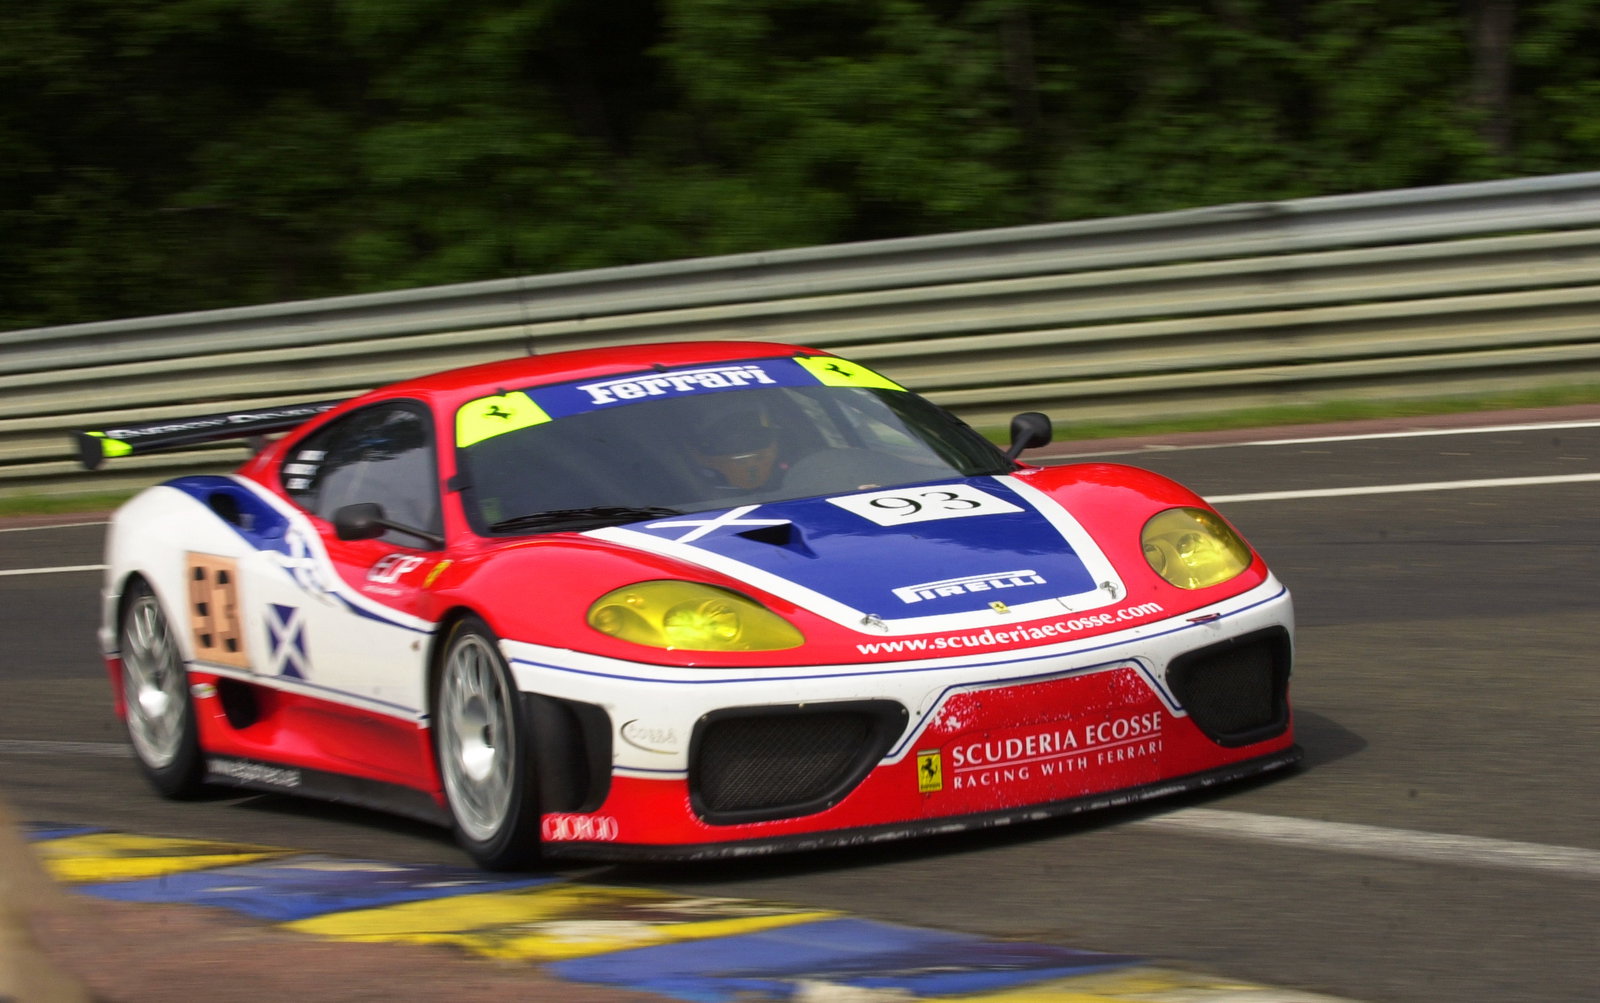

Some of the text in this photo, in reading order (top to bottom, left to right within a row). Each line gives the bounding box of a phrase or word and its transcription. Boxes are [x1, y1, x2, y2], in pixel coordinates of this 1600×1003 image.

[576, 365, 776, 405] Ferrari
[869, 490, 982, 517] 93
[891, 569, 1047, 604] PIRELLI
[856, 600, 1164, 655] www.scuderiaecosse.com
[952, 710, 1163, 768] SCUDERIA ECOSSE
[953, 740, 1164, 790] RACING WITH FERRARI
